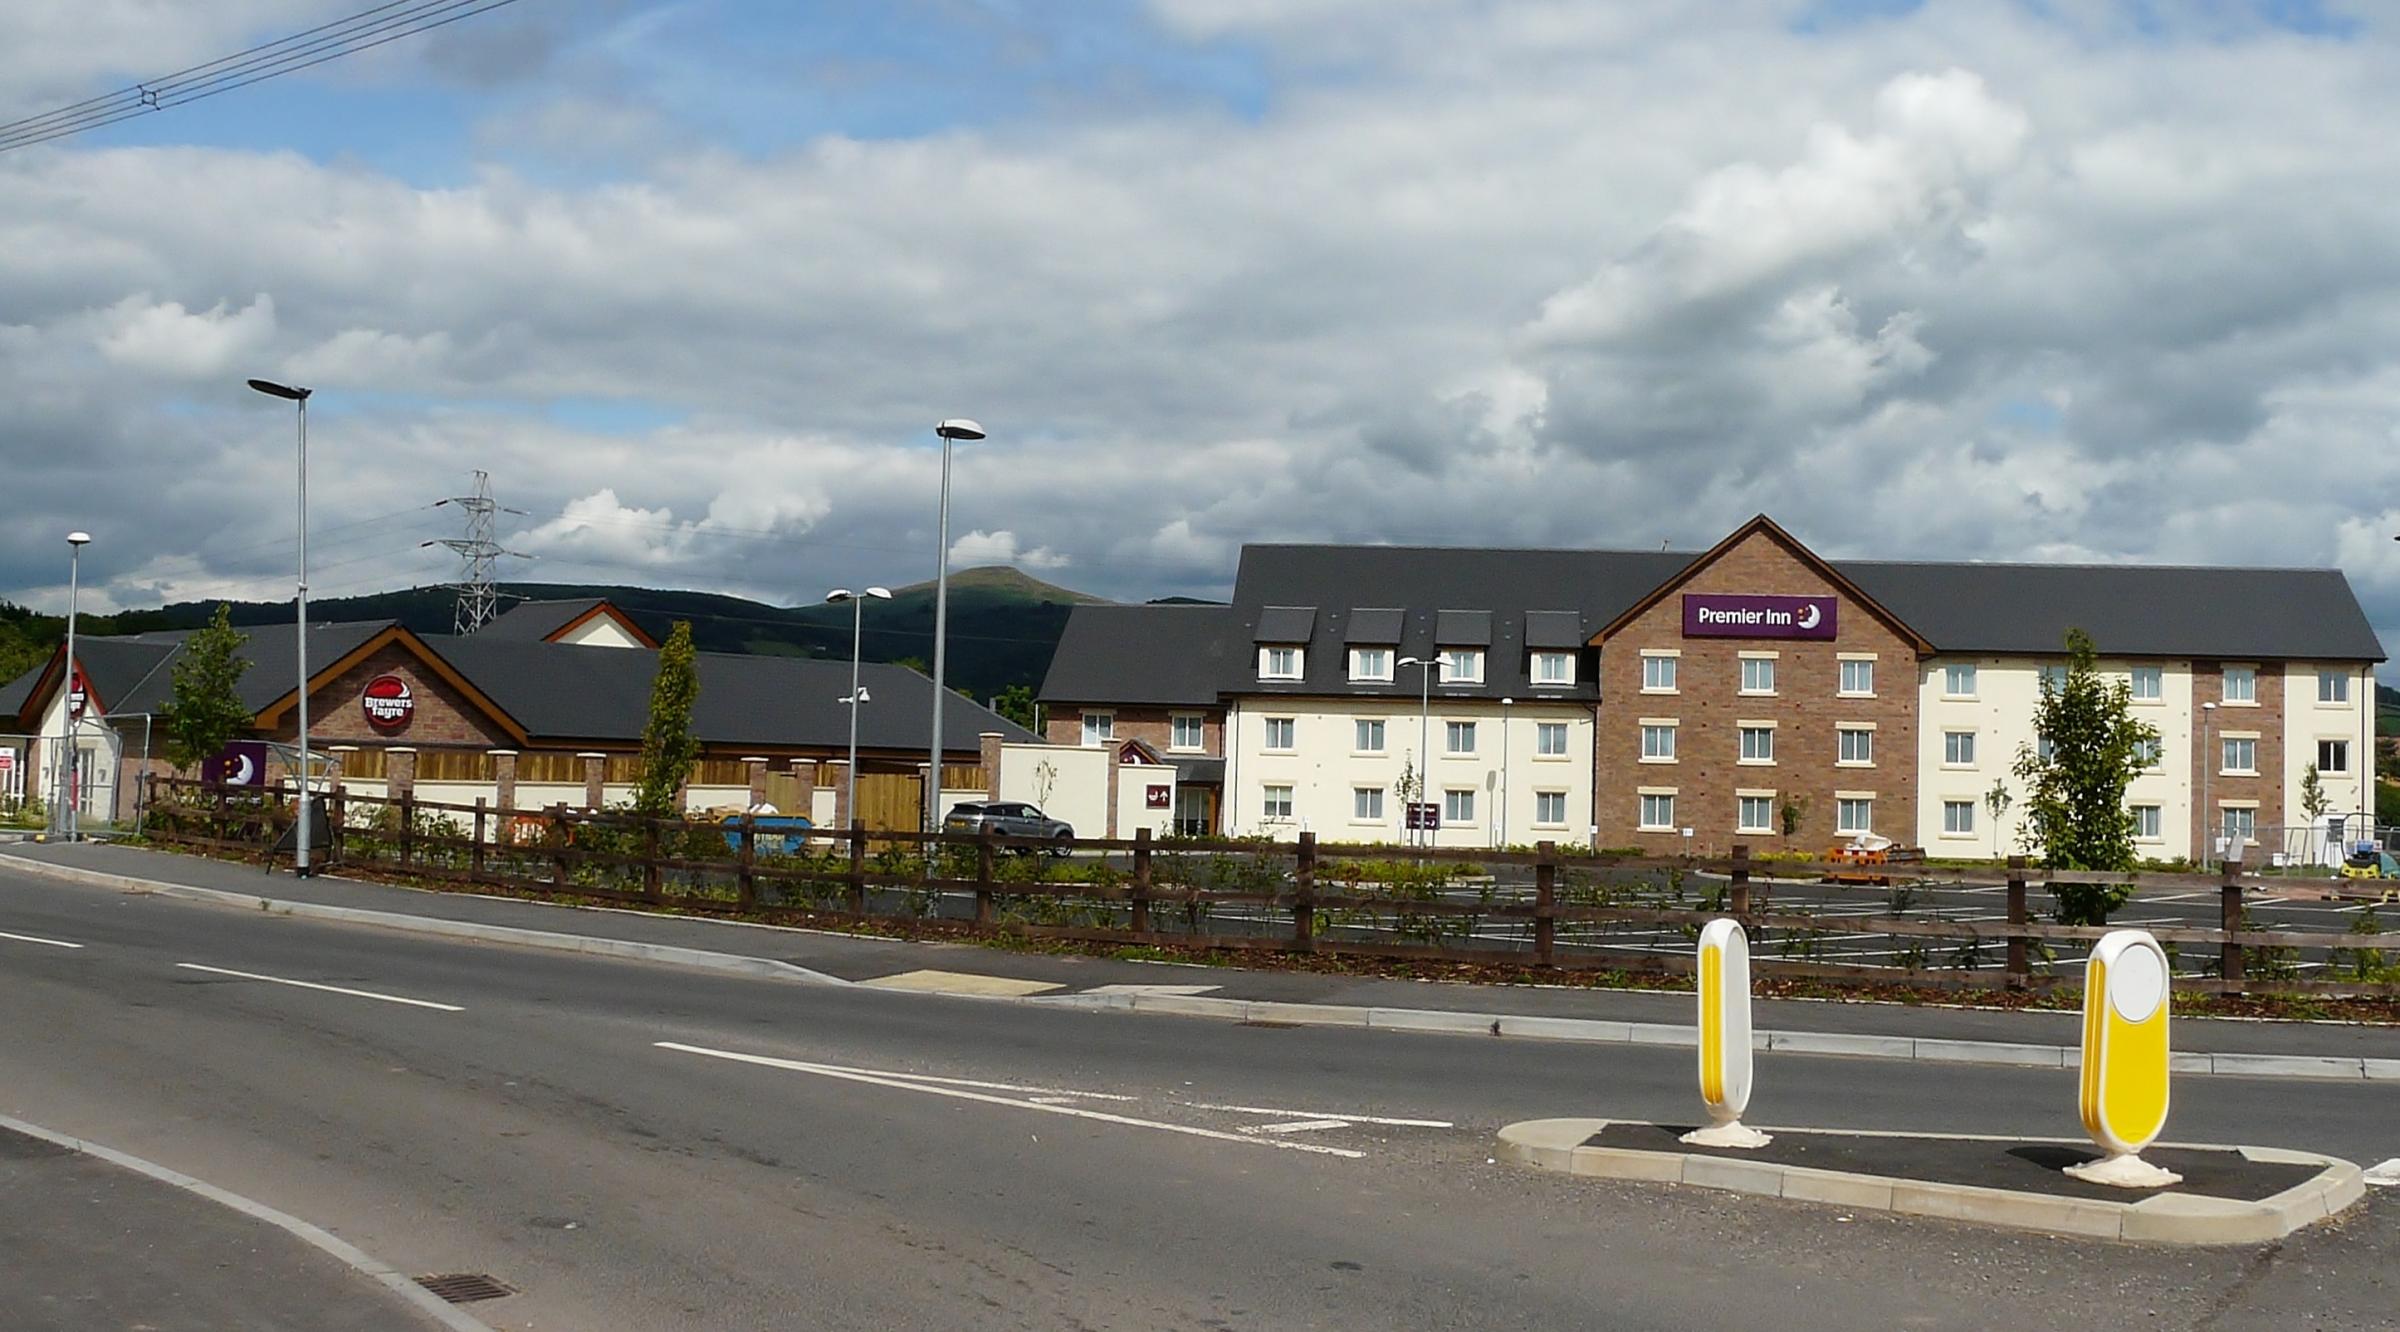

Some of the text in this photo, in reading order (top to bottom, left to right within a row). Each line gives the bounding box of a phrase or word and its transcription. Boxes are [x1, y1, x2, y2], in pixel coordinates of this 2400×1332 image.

[1699, 607, 1791, 625] Premier Inn
[365, 697, 413, 708] Brewers
